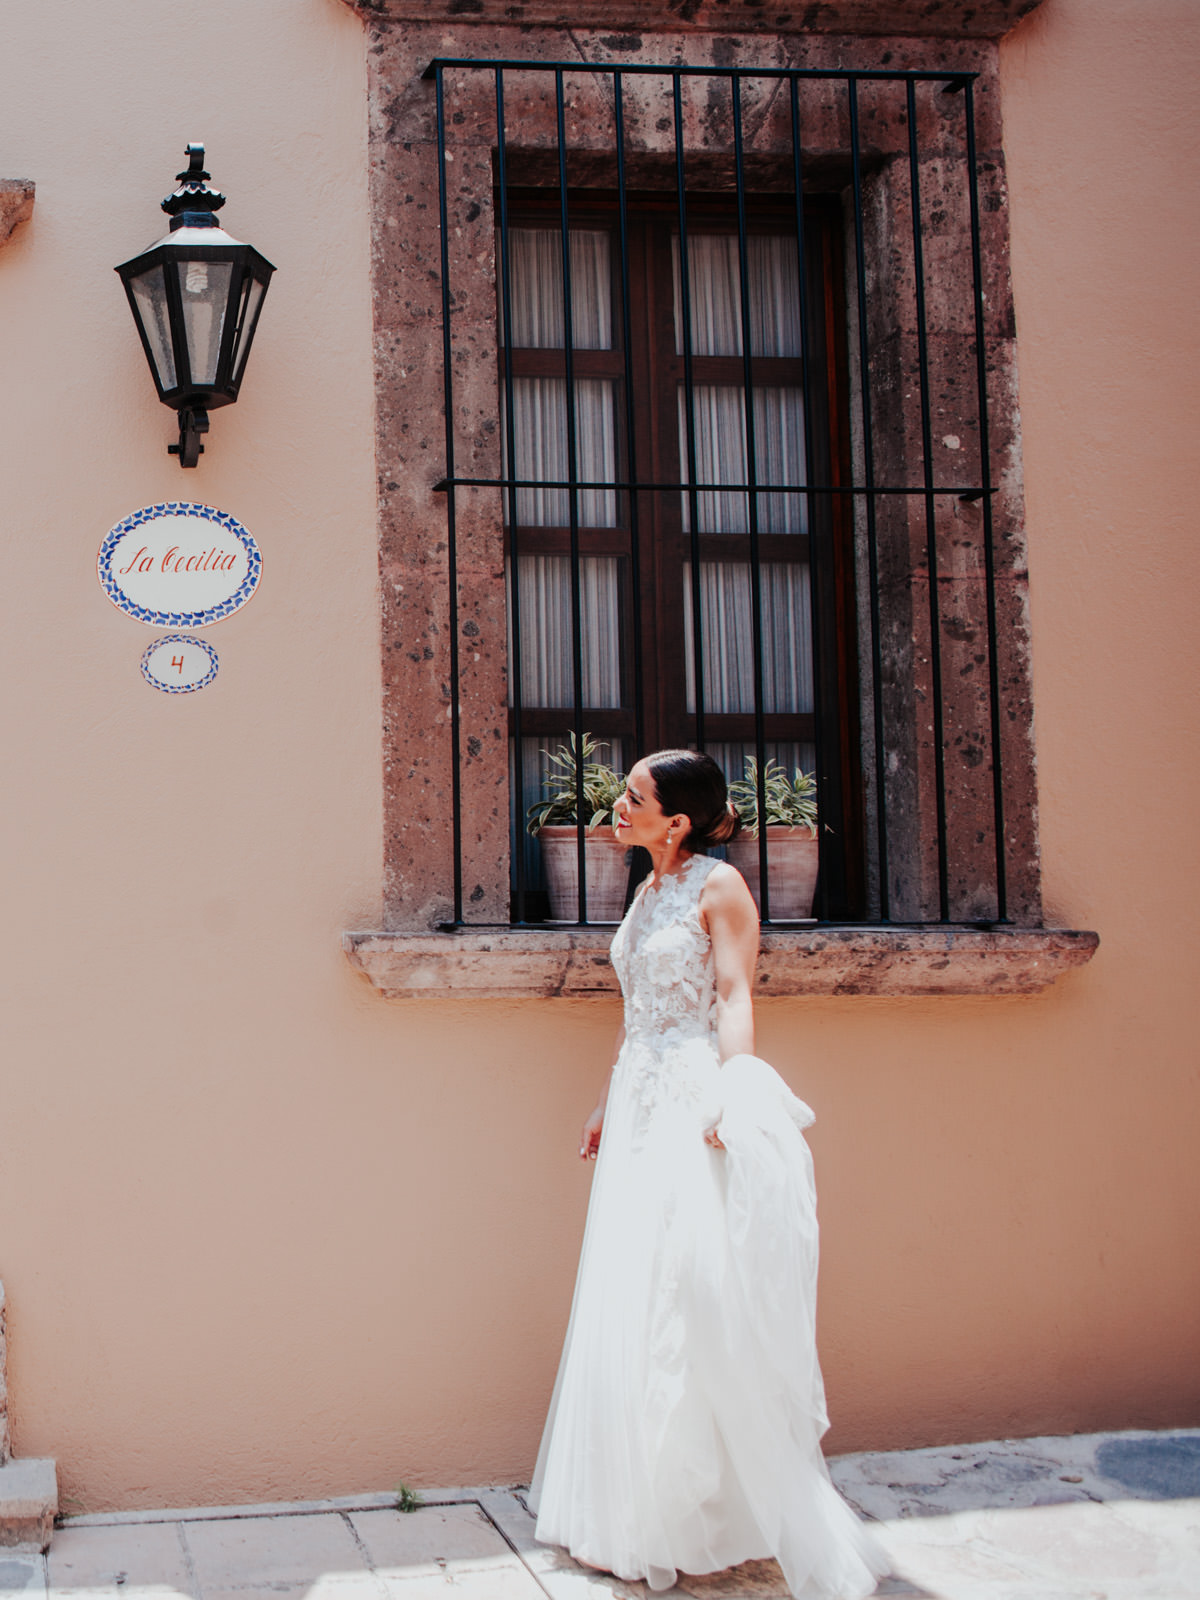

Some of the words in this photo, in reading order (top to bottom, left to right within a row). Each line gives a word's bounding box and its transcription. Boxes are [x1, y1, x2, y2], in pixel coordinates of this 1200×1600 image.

[119, 546, 155, 574] La
[161, 546, 237, 574] Cecilia
[170, 655, 184, 674] 4
